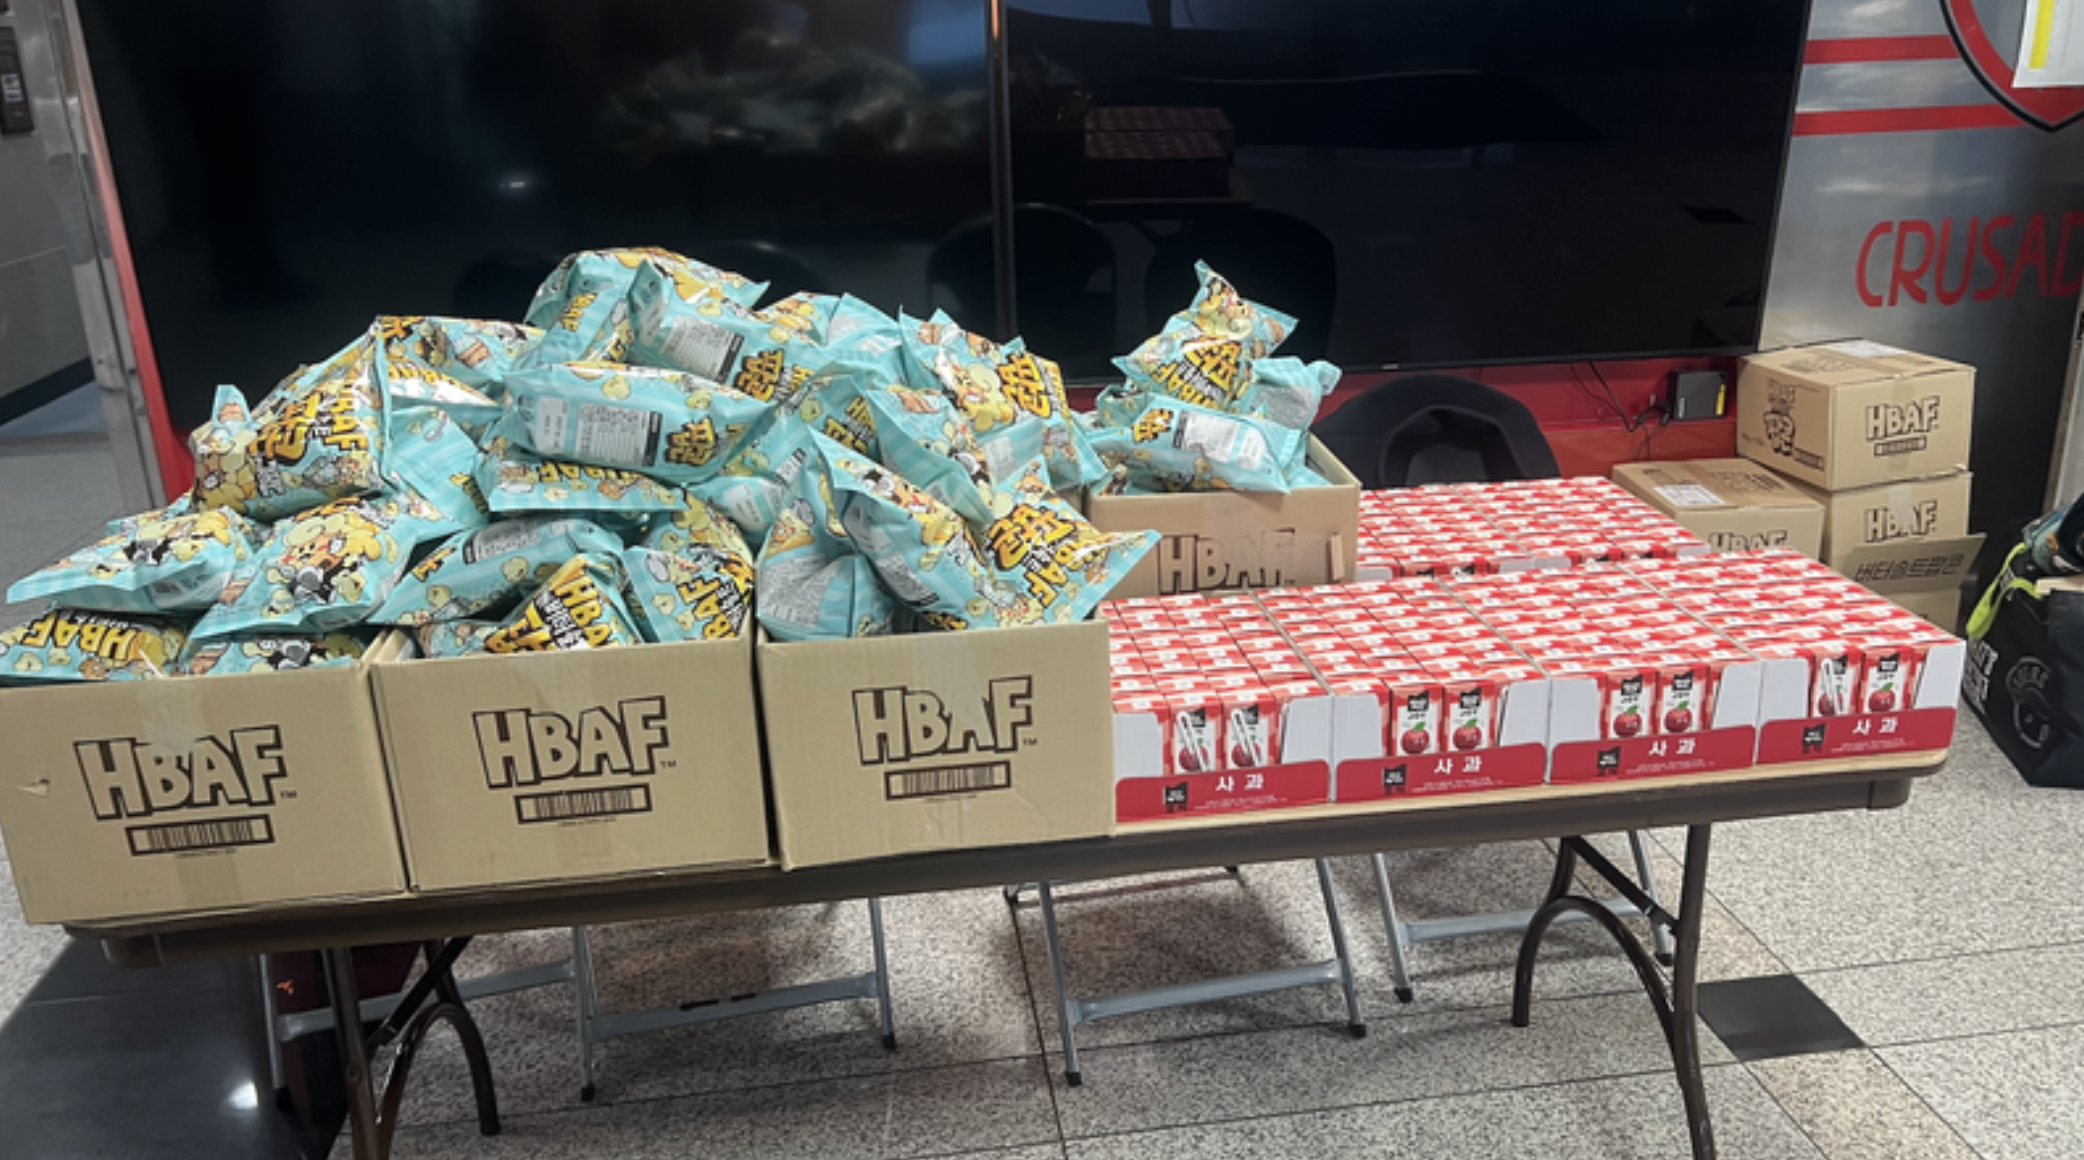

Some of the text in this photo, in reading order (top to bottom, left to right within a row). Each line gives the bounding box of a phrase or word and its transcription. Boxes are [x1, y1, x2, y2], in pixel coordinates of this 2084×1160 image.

[1866, 395, 1940, 442] HBAF
[20, 609, 138, 661] HBAF
[553, 574, 613, 649] HBA
[472, 695, 669, 789] HBAF
[852, 675, 1032, 766] HBAF
[73, 724, 288, 821] HBAF
